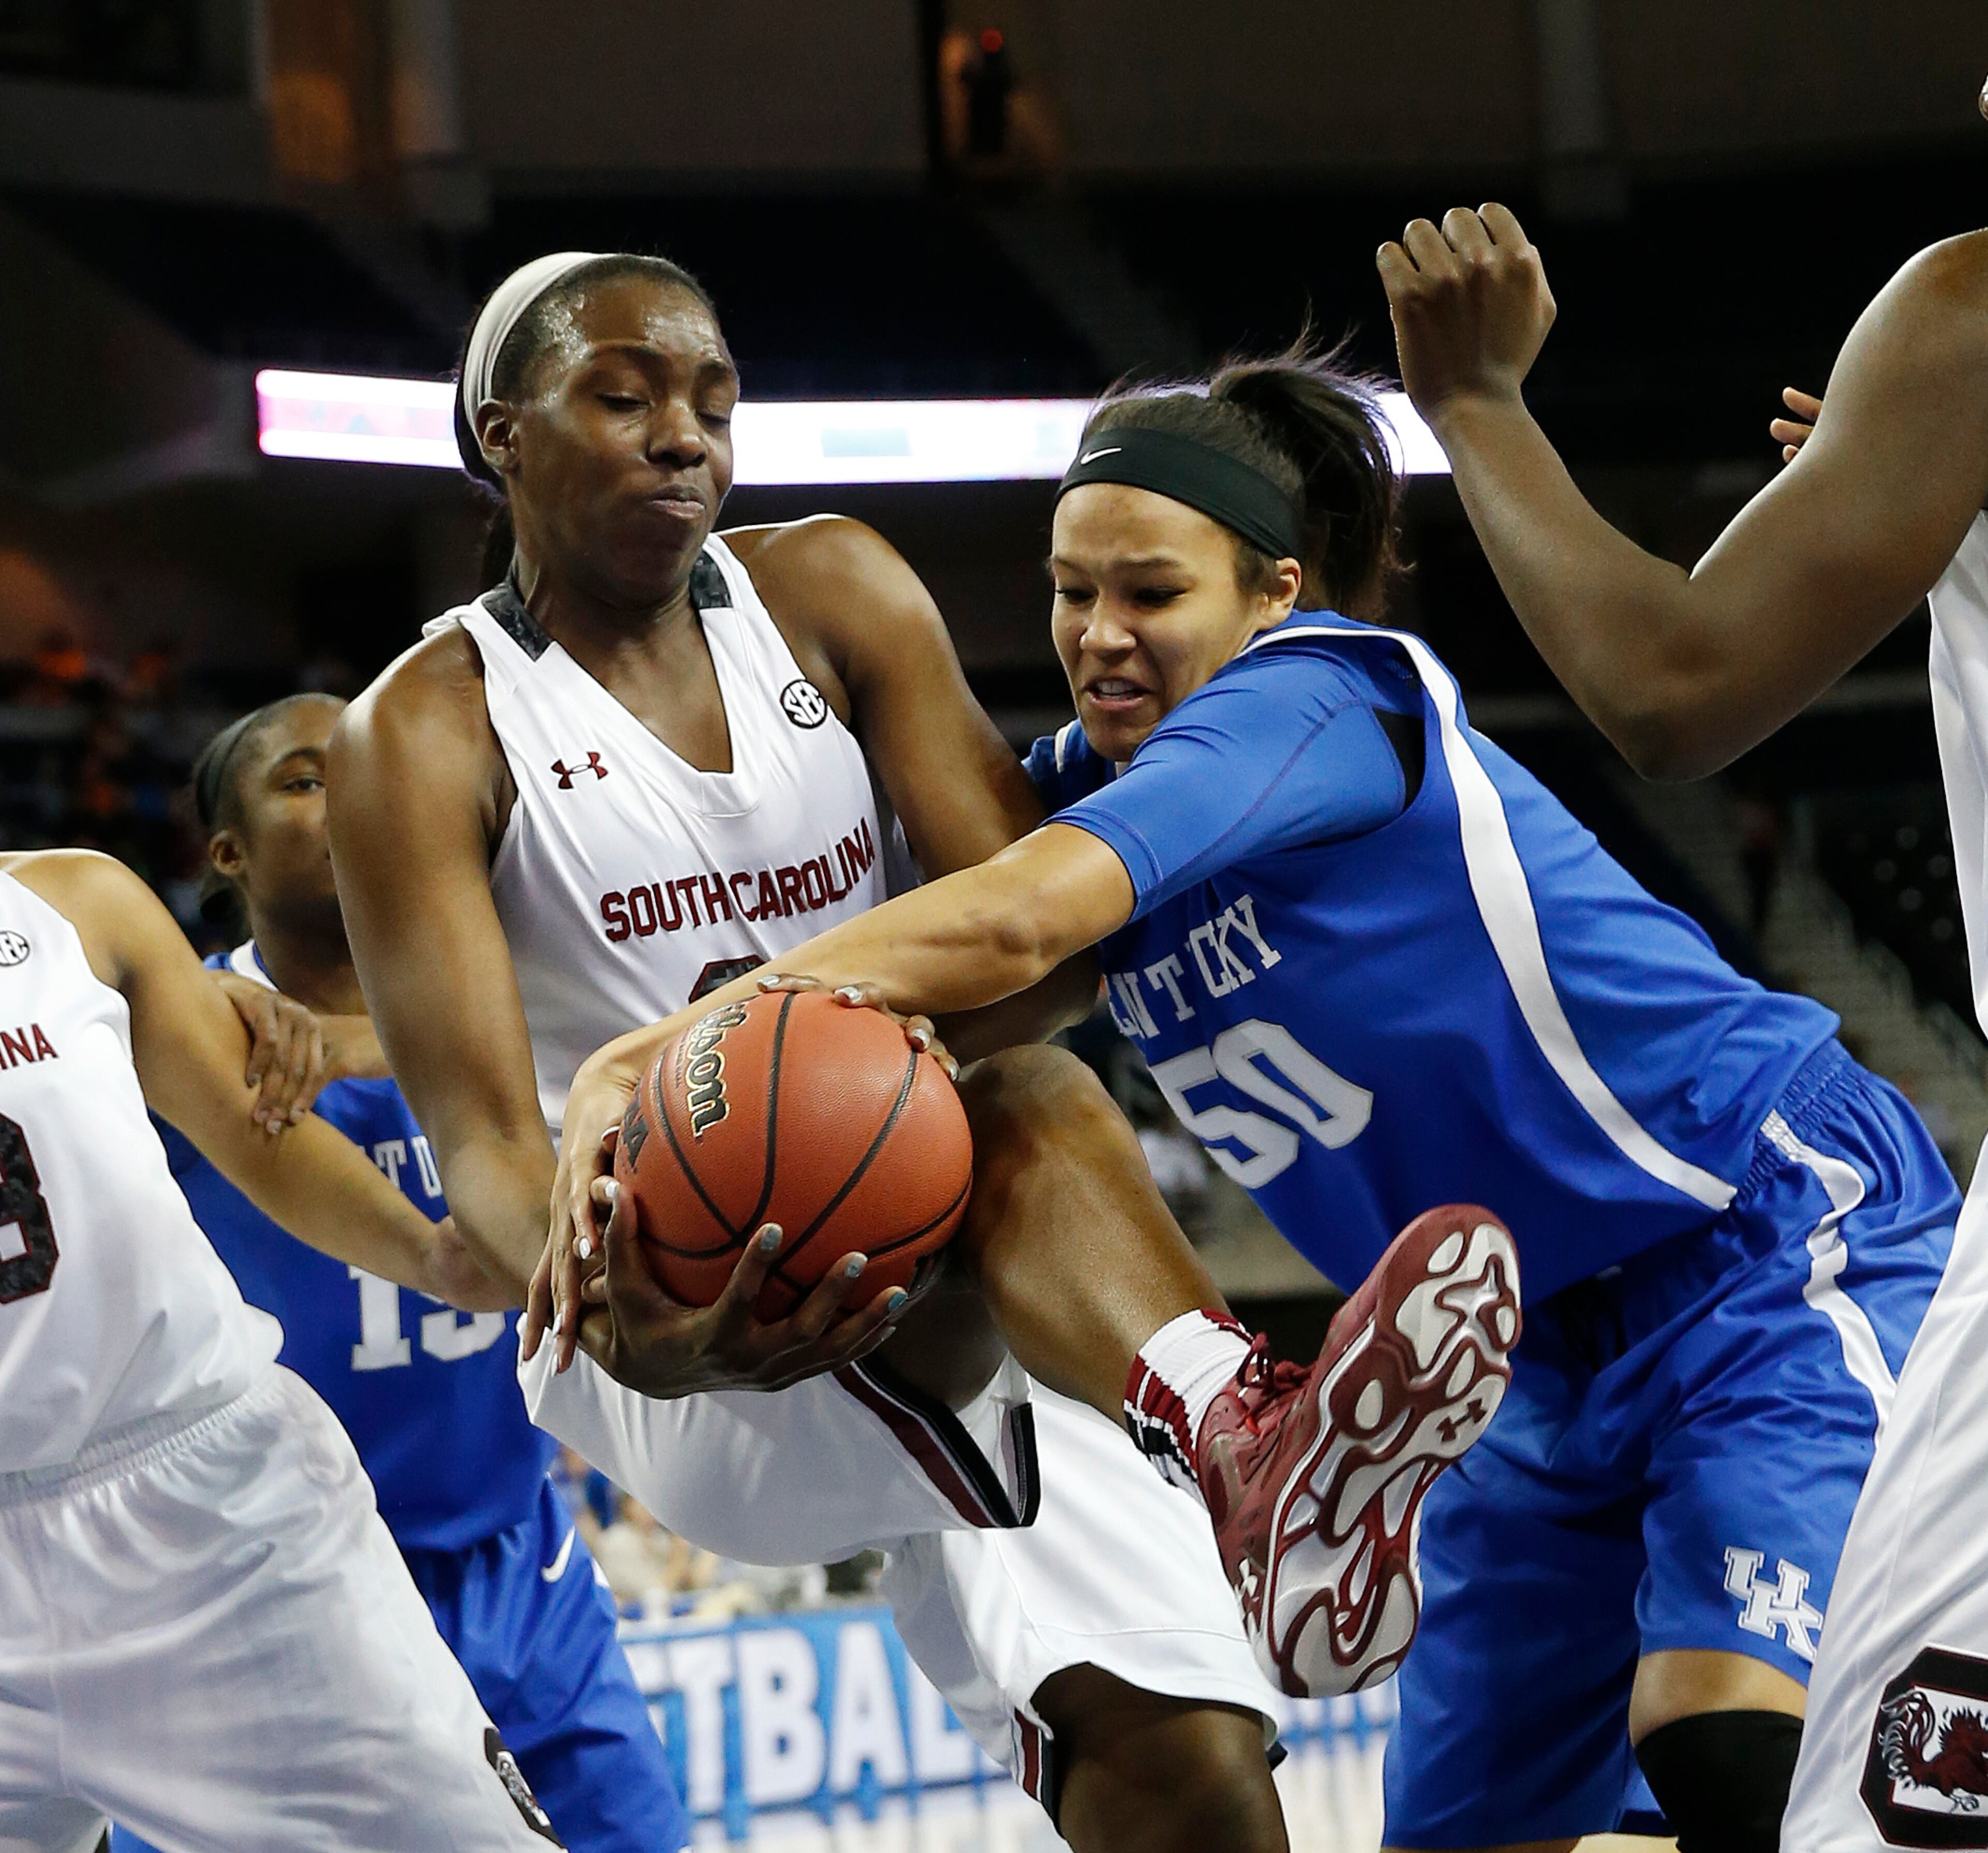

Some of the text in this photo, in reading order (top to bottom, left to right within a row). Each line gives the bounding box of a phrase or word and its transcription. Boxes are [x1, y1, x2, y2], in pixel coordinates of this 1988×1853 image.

[780, 679, 827, 729] SEC
[600, 816, 875, 942] SOUTH CAROLINA
[1148, 1018, 1373, 1189] 50
[1723, 1545, 1823, 1665] UK
